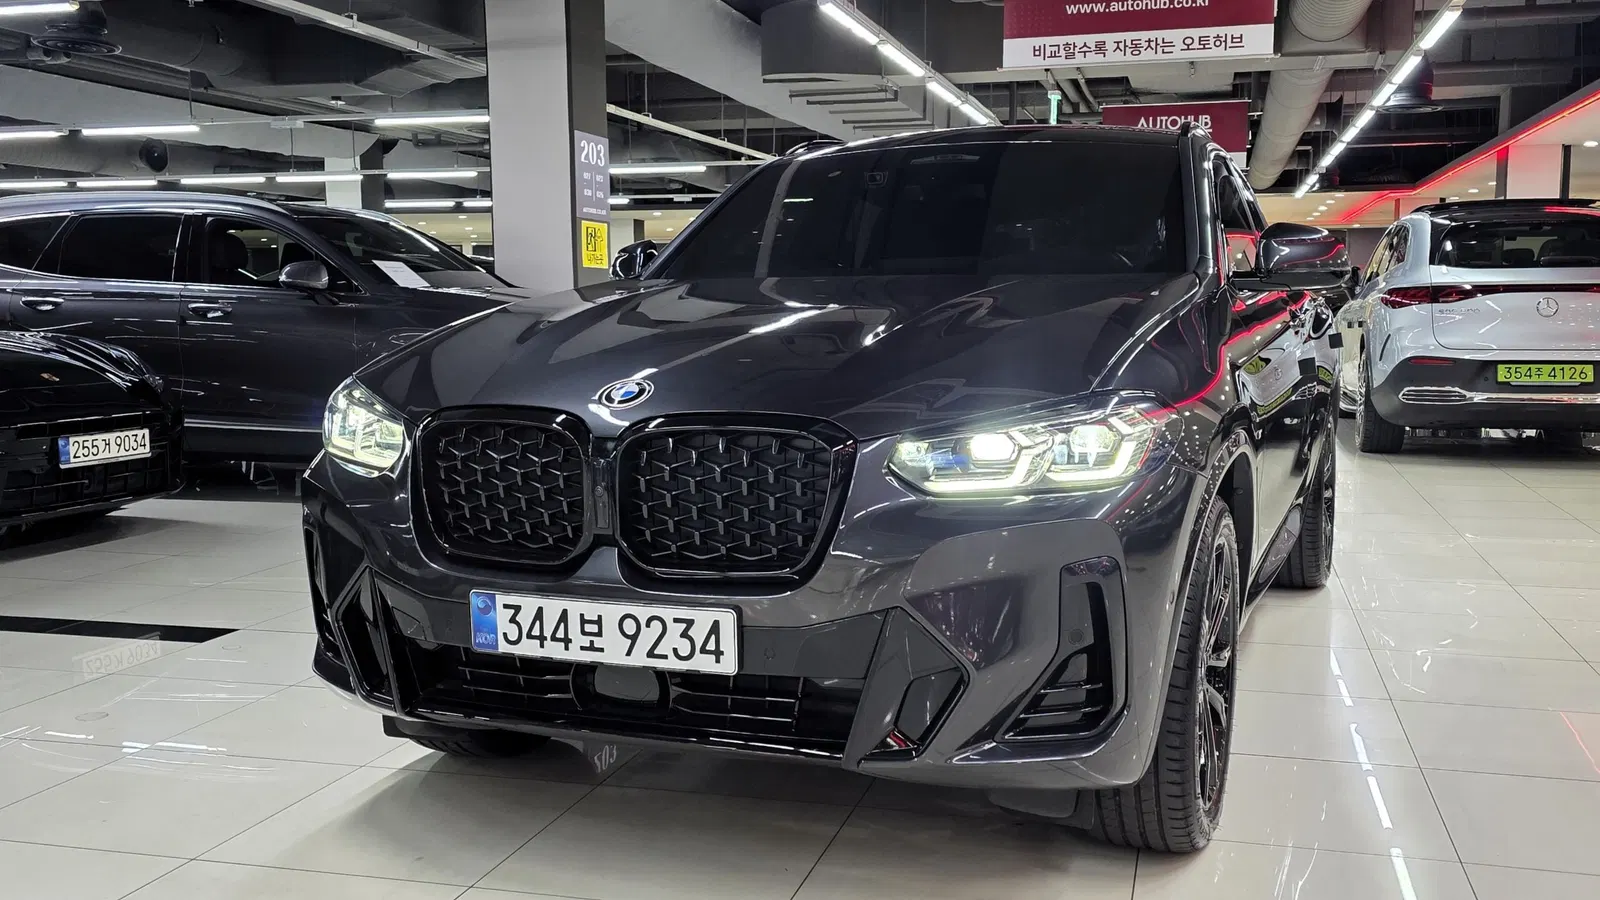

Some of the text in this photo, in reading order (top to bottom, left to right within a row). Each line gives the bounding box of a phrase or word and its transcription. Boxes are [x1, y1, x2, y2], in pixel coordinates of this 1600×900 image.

[1032, 33, 1245, 61] 비교할수록 자동차는 오토허브
[580, 140, 605, 166] 203
[1503, 366, 1588, 380] 354주 4126
[71, 432, 147, 459] 255거 9034
[502, 603, 725, 664] 344보 9234
